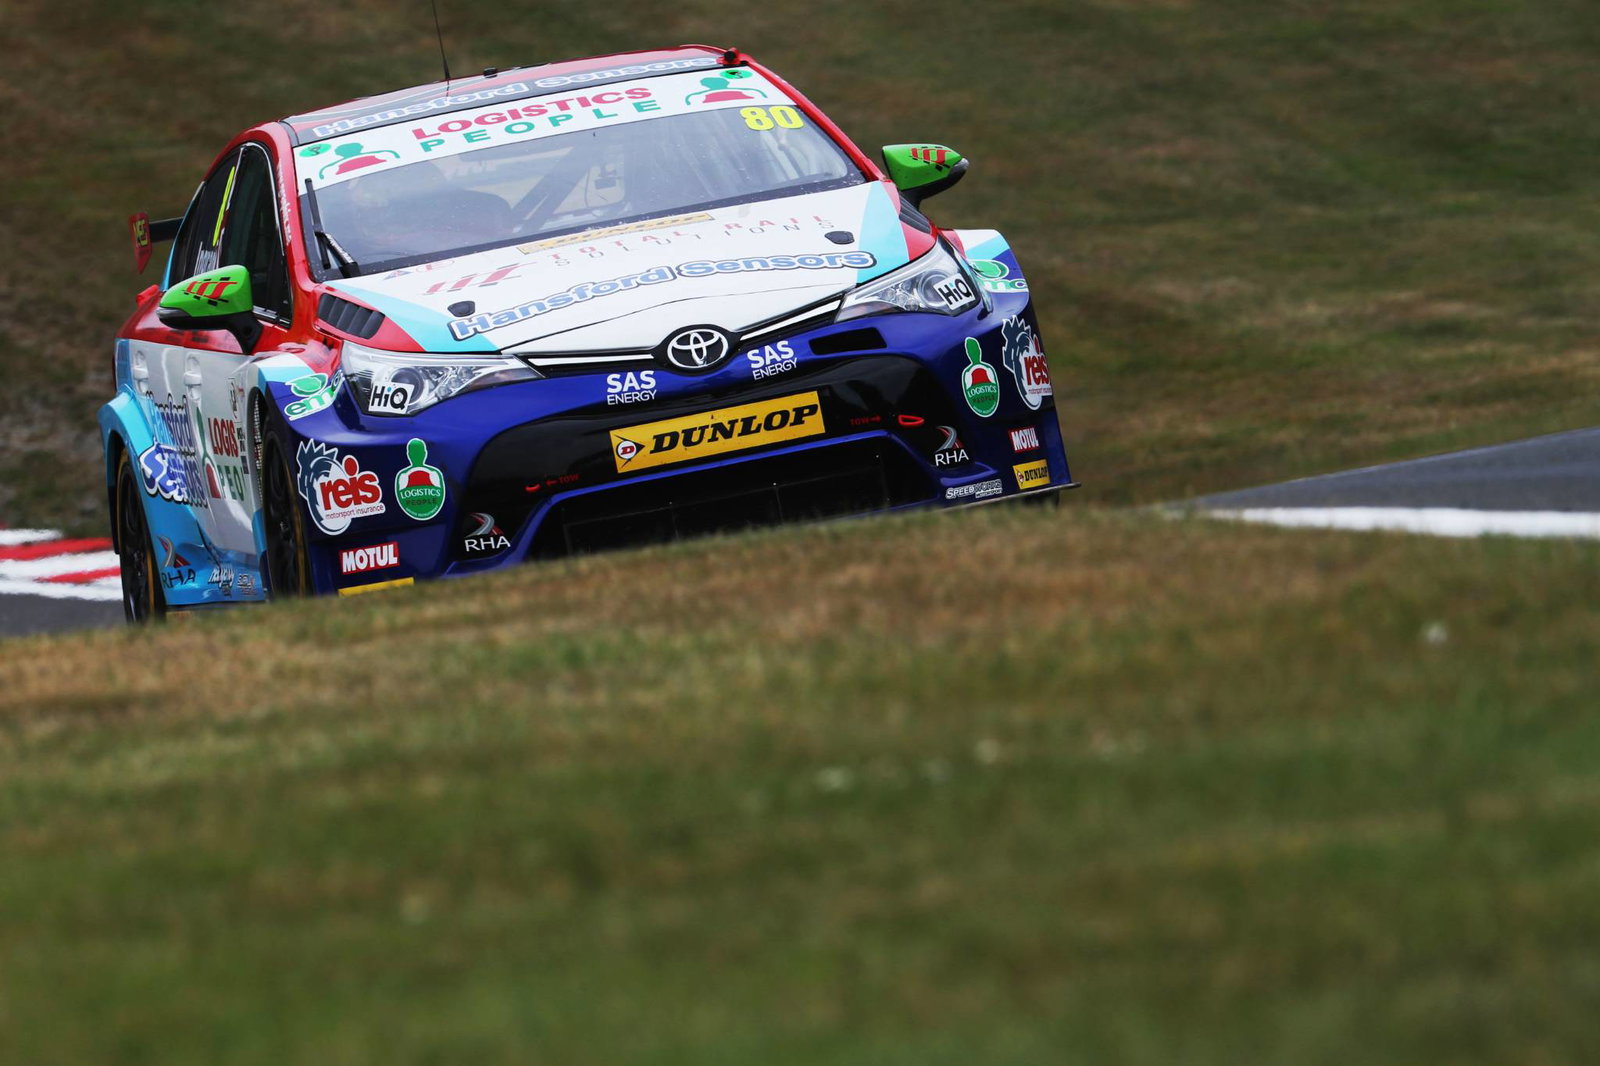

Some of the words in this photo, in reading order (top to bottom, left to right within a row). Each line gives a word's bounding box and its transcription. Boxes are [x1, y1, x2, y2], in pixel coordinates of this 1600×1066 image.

[313, 81, 530, 138] Hansford
[534, 57, 716, 88] Sensors
[412, 87, 652, 140] LOGISTICS
[740, 105, 805, 131] 80
[420, 99, 661, 153] PEOPLE
[450, 267, 674, 339] Hansford
[679, 251, 875, 277] Sensors
[938, 278, 973, 306] HiQ
[747, 340, 795, 369] SAS
[752, 357, 798, 381] ENERGY
[606, 370, 657, 393] SAS
[967, 385, 997, 398] LOGISTICS
[371, 385, 408, 409] HiQ
[607, 389, 657, 405] ENERGY
[650, 403, 819, 454] DUNLOP
[1012, 427, 1040, 451] MOTUL
[935, 449, 969, 467] RHA
[319, 456, 381, 511] reis
[1024, 465, 1048, 482] DUNLOP
[400, 488, 441, 500] LOGISTICS
[325, 510, 355, 521] motorsport
[355, 504, 384, 516] insurance
[464, 535, 511, 552] RHA
[342, 543, 398, 573] MOTUL
